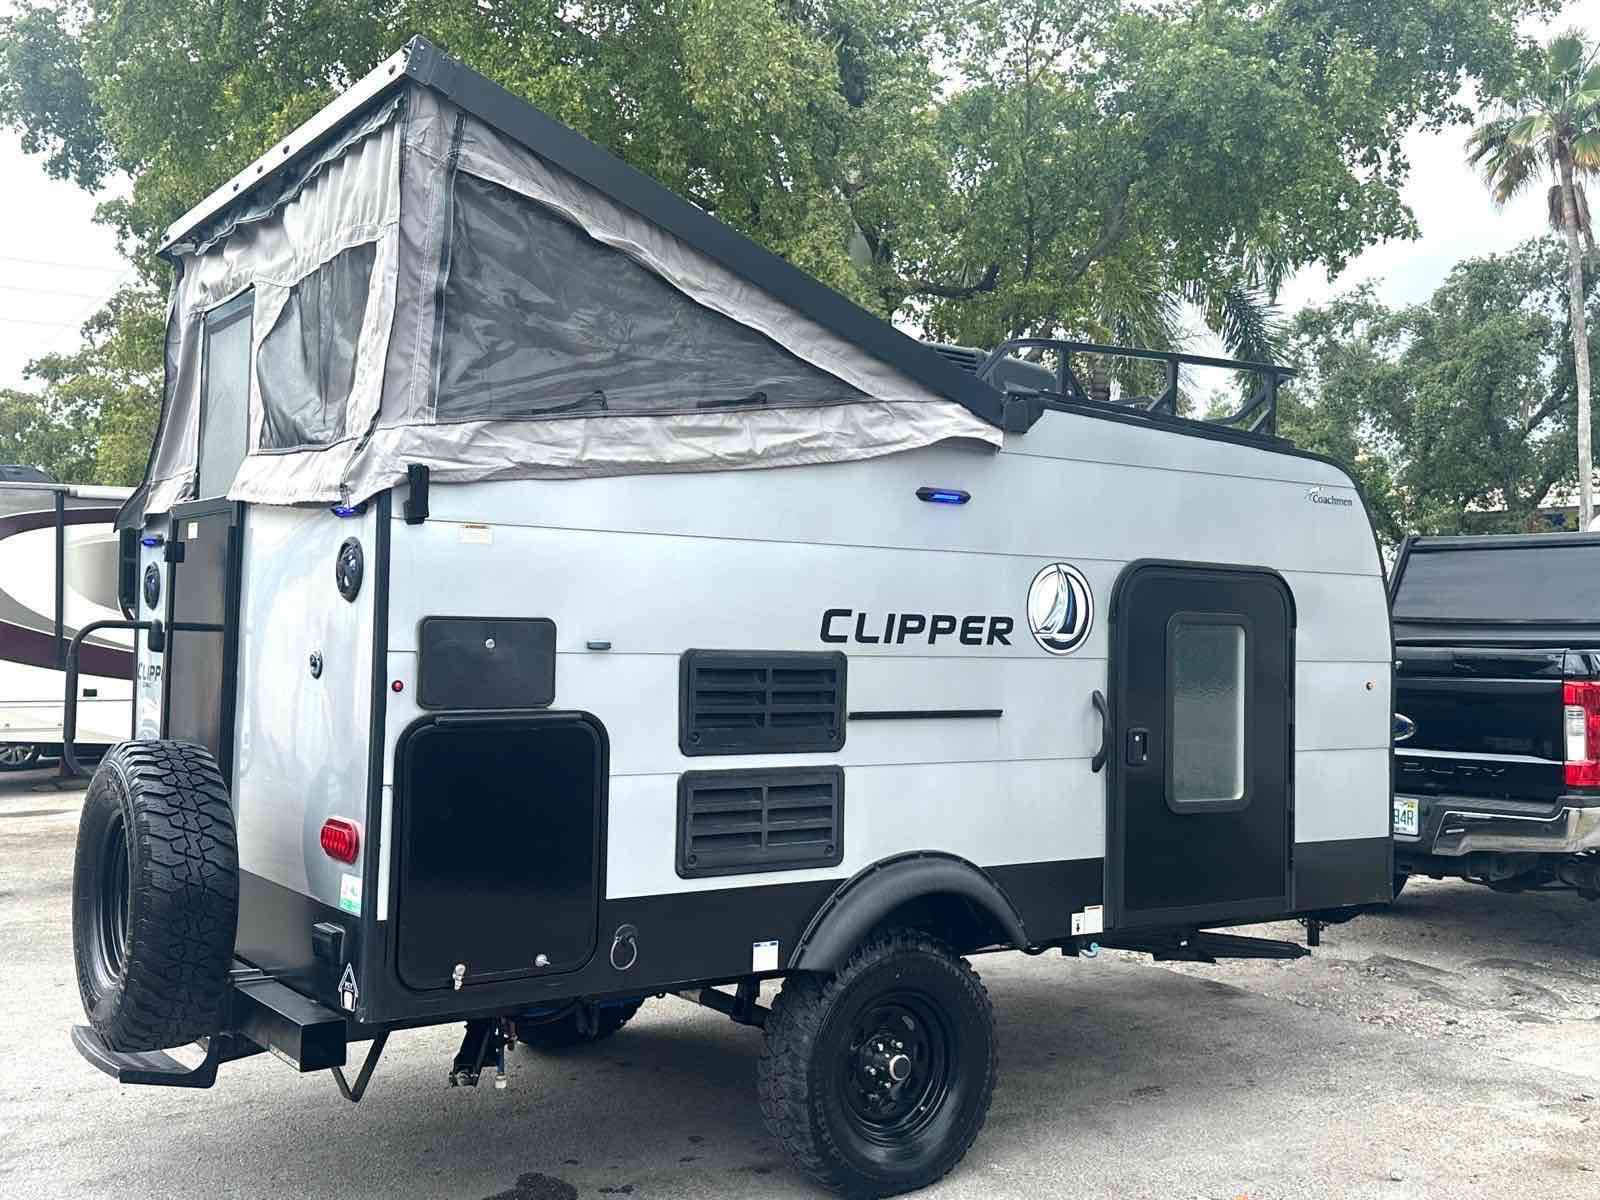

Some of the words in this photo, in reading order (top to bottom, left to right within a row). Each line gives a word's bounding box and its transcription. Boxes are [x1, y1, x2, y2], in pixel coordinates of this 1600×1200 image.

[1312, 494, 1353, 506] Coachmen
[820, 608, 1014, 646] CLIPPER
[1402, 761, 1505, 777] DUTY
